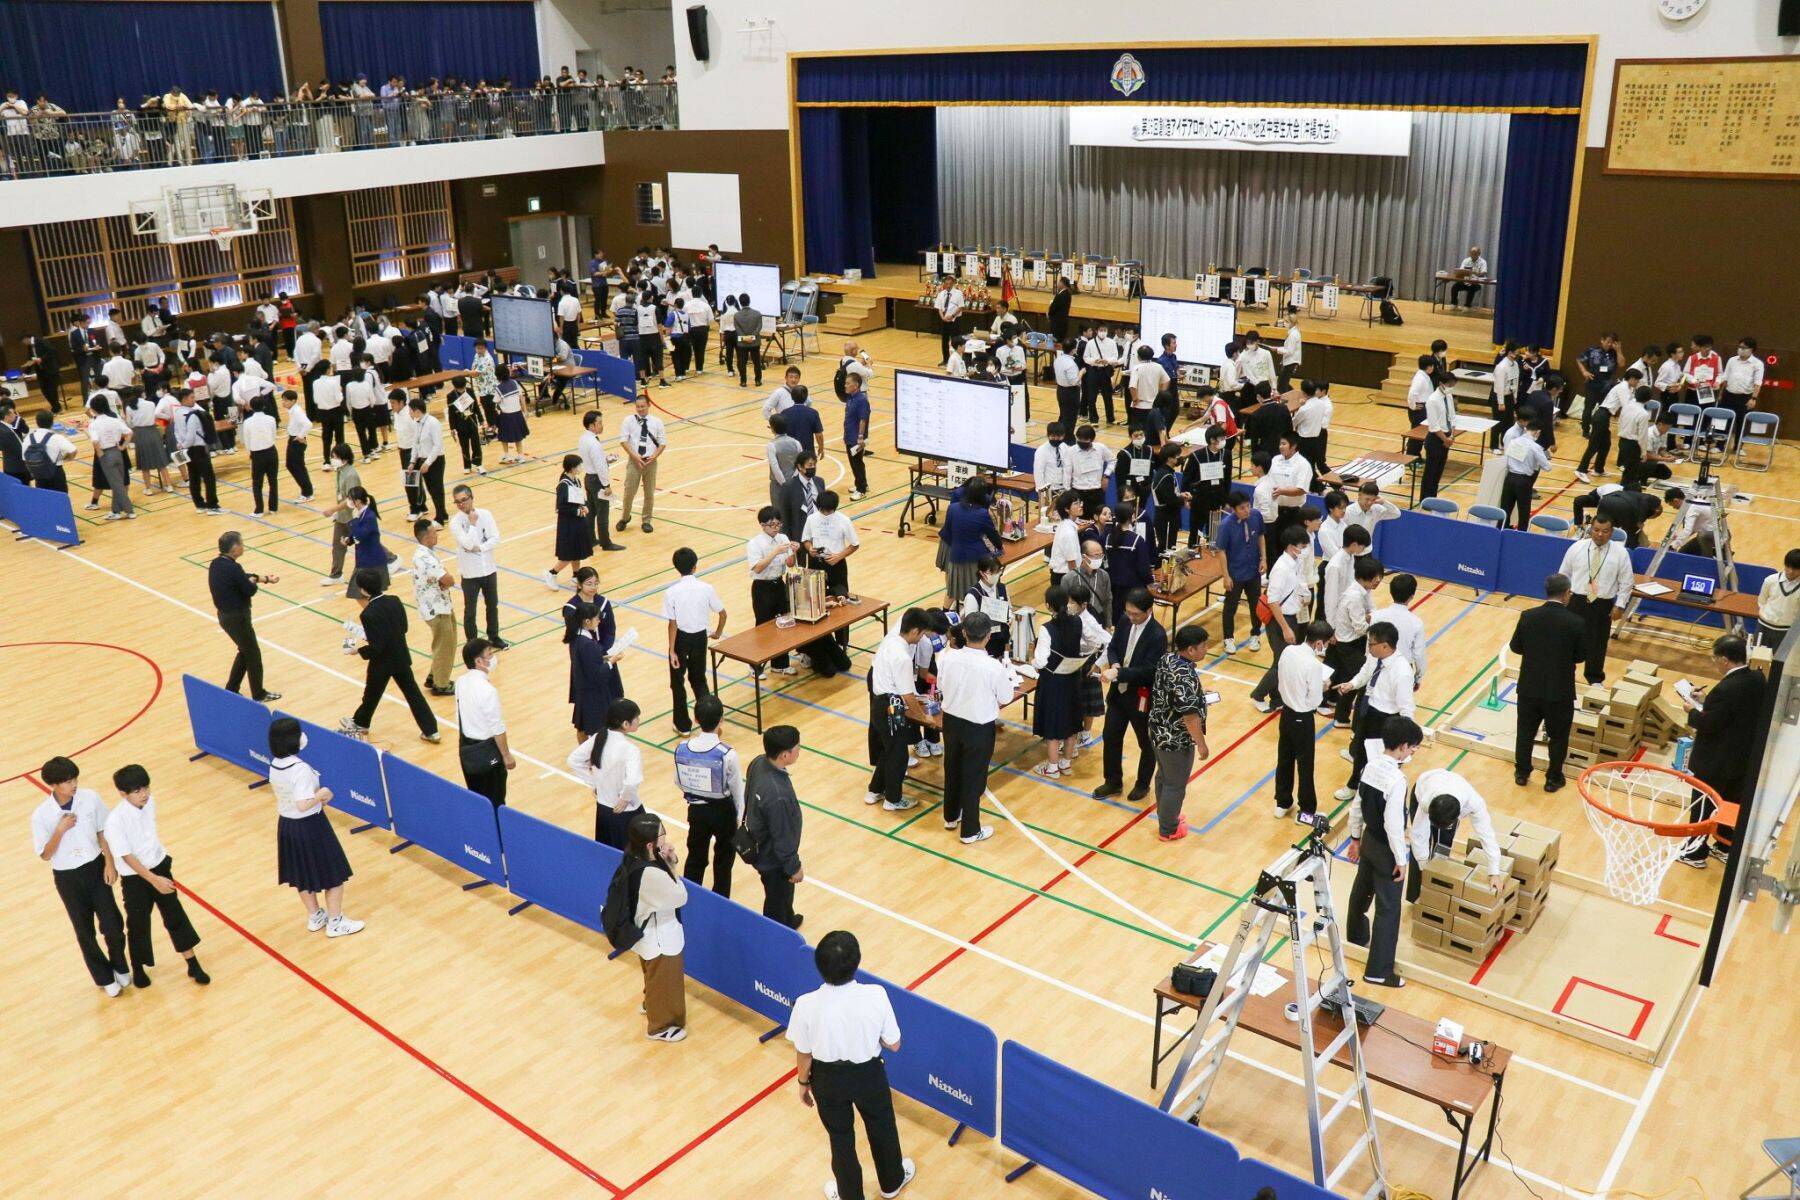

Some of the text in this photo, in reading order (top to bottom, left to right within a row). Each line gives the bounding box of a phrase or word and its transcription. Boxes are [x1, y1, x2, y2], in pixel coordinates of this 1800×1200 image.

[954, 465, 969, 475] 車検
[1457, 562, 1486, 577] Nittaku
[1690, 580, 1706, 591] 150
[754, 979, 792, 1008] Nittaku
[928, 1072, 974, 1107] Nittaku
